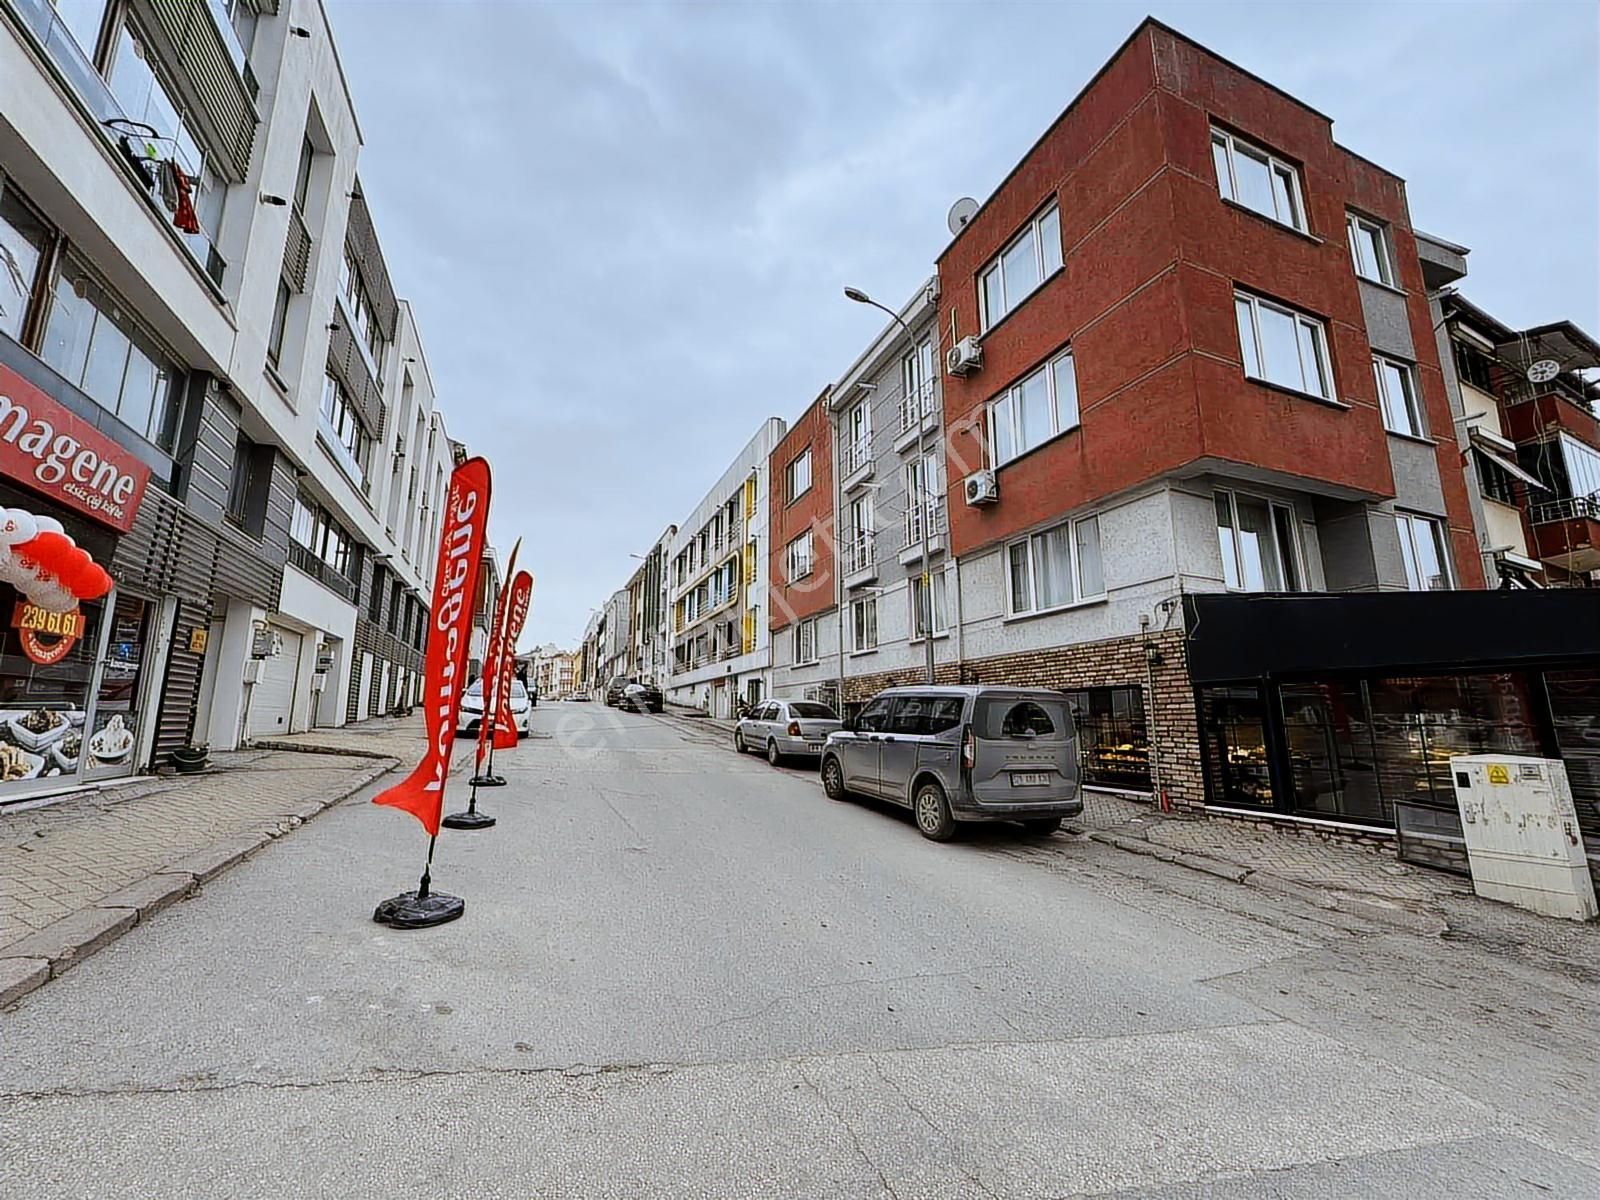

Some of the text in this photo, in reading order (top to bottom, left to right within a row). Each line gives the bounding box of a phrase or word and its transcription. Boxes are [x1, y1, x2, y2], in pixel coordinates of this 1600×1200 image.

[21, 605, 77, 636] 239 61 61
